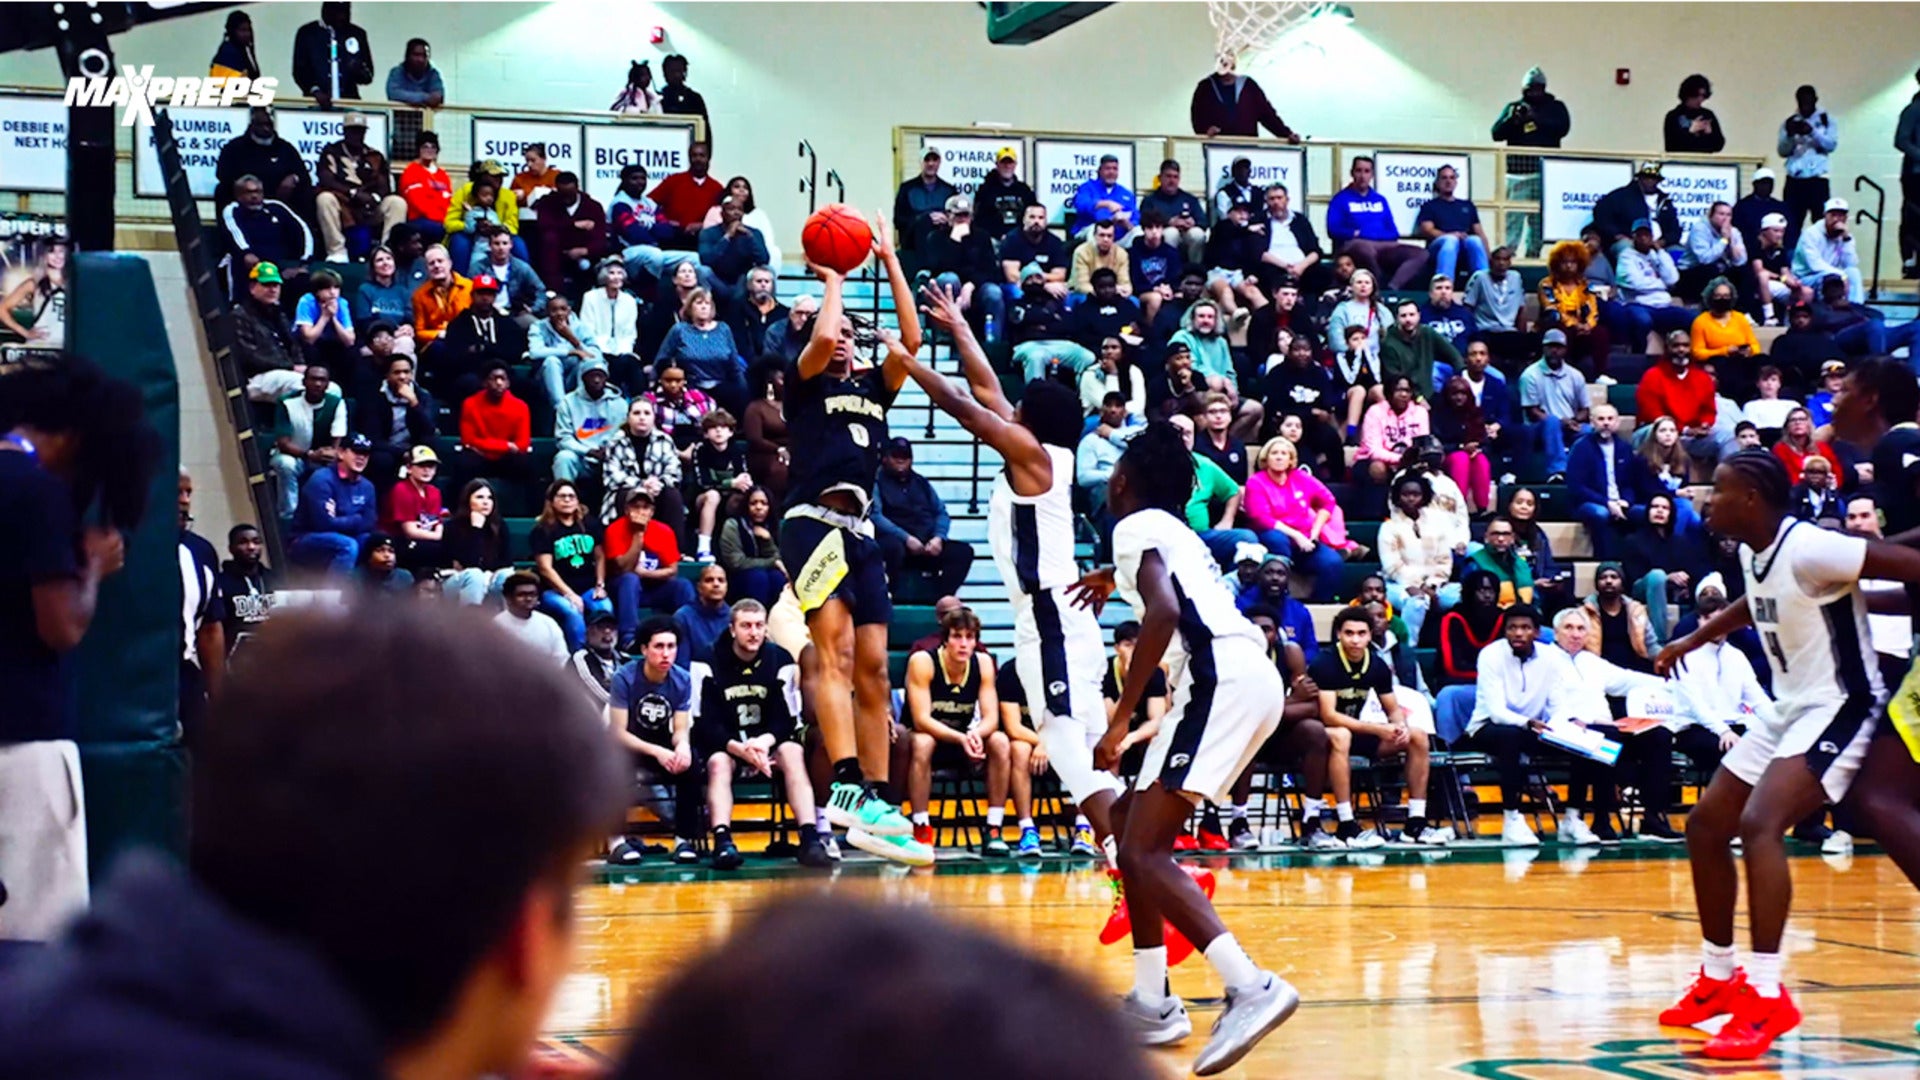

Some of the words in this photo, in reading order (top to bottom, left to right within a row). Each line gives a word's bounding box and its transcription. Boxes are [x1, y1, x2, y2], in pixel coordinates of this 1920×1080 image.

[3, 120, 50, 134] DEBBIE
[14, 136, 49, 148] NEXT
[190, 137, 201, 150] &
[595, 148, 629, 166] BIG
[633, 149, 681, 168] TIME
[1074, 154, 1097, 166] THE
[1397, 181, 1421, 193] BAR
[1660, 177, 1691, 188] CHAD
[1693, 178, 1728, 190] JONES
[848, 422, 870, 447] 0
